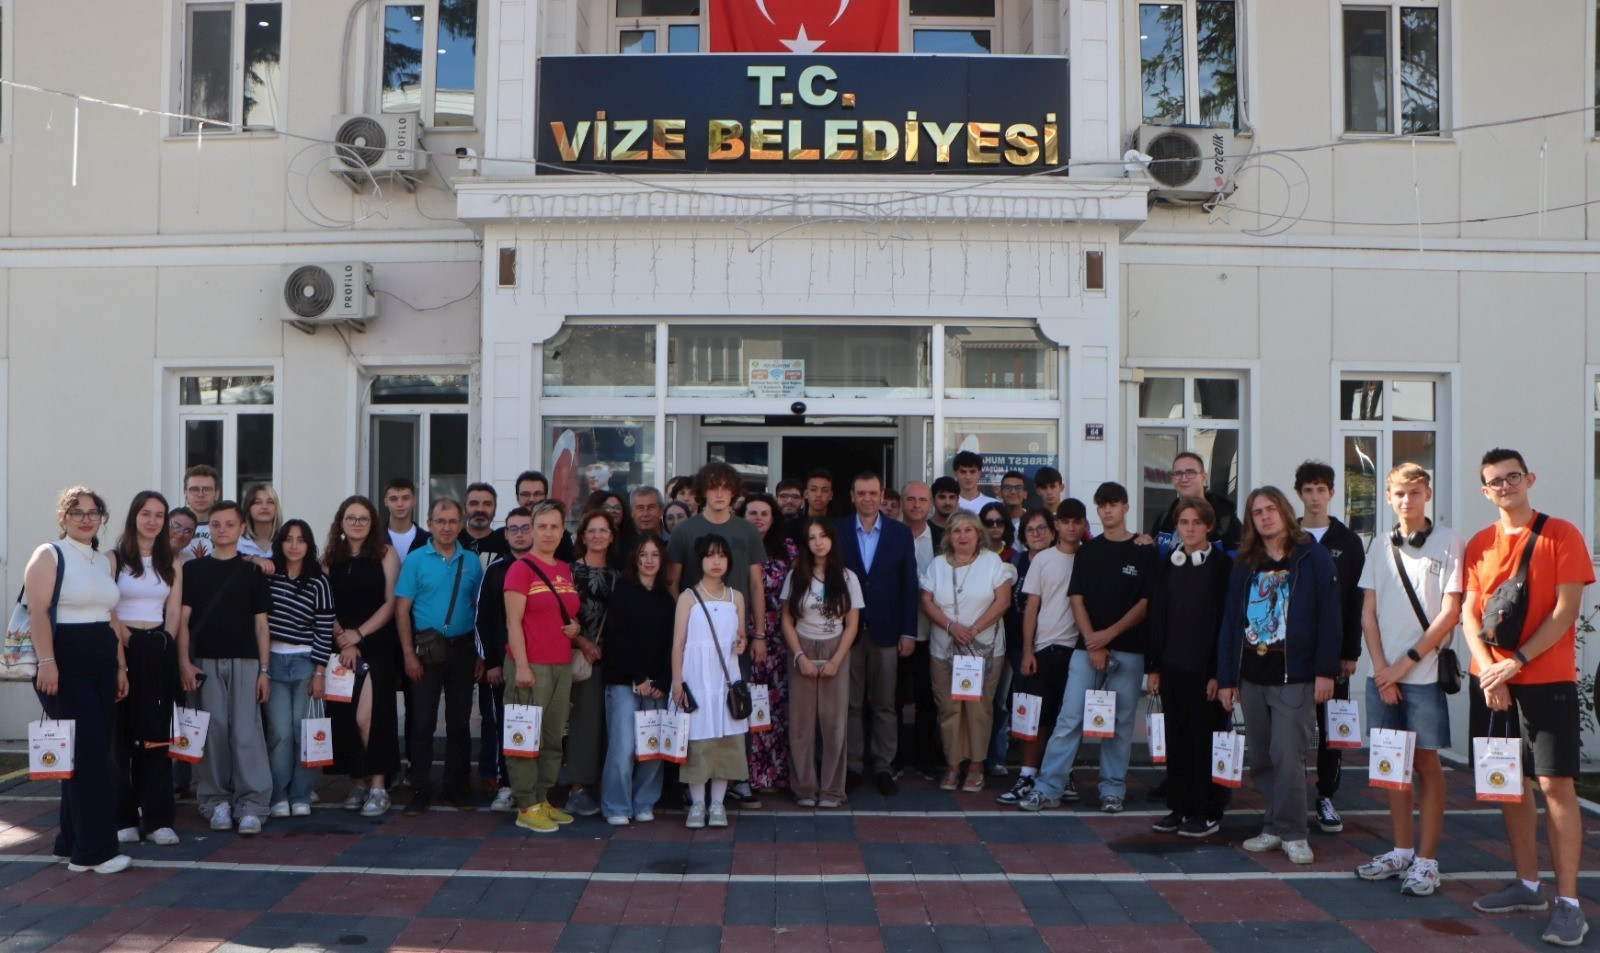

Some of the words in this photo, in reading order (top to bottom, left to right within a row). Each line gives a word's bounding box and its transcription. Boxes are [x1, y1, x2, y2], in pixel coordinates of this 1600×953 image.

[747, 65, 855, 108] T.C.
[549, 110, 687, 162] VİZE
[708, 110, 1060, 166] BELEDİYESİ
[1212, 133, 1227, 175] arçelik
